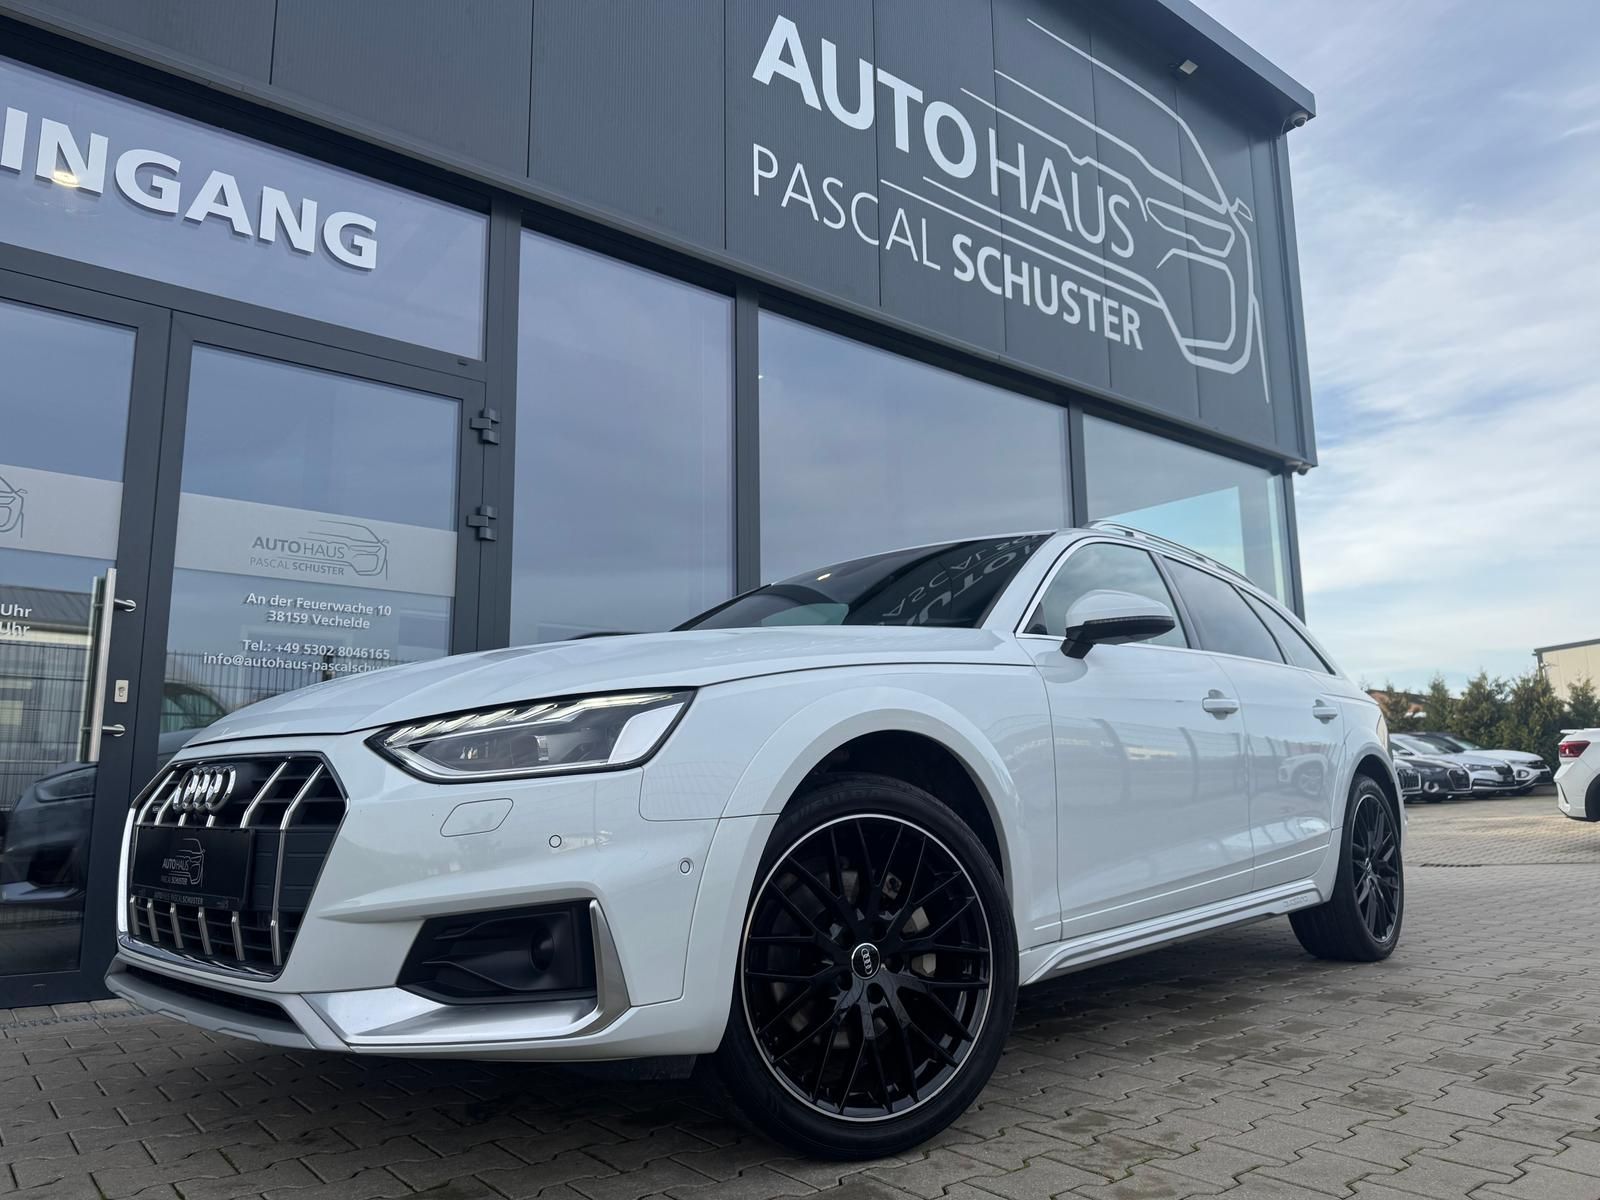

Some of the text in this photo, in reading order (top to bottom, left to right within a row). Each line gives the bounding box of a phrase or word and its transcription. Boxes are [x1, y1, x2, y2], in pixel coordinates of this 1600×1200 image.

[752, 14, 1135, 259] AUTOHAUS
[752, 143, 1144, 351] PASCAL SCHUSTER
[252, 536, 345, 560] AUTOHAUS
[250, 557, 345, 576] PASCAL SCHUSTER
[0, 603, 32, 618] Uhr
[246, 592, 392, 616] An der Feuerwache 10
[0, 621, 30, 637] Uhr
[267, 610, 371, 629] 38159 Vechelde
[242, 639, 391, 660] Tel.: +49 5302 8046165
